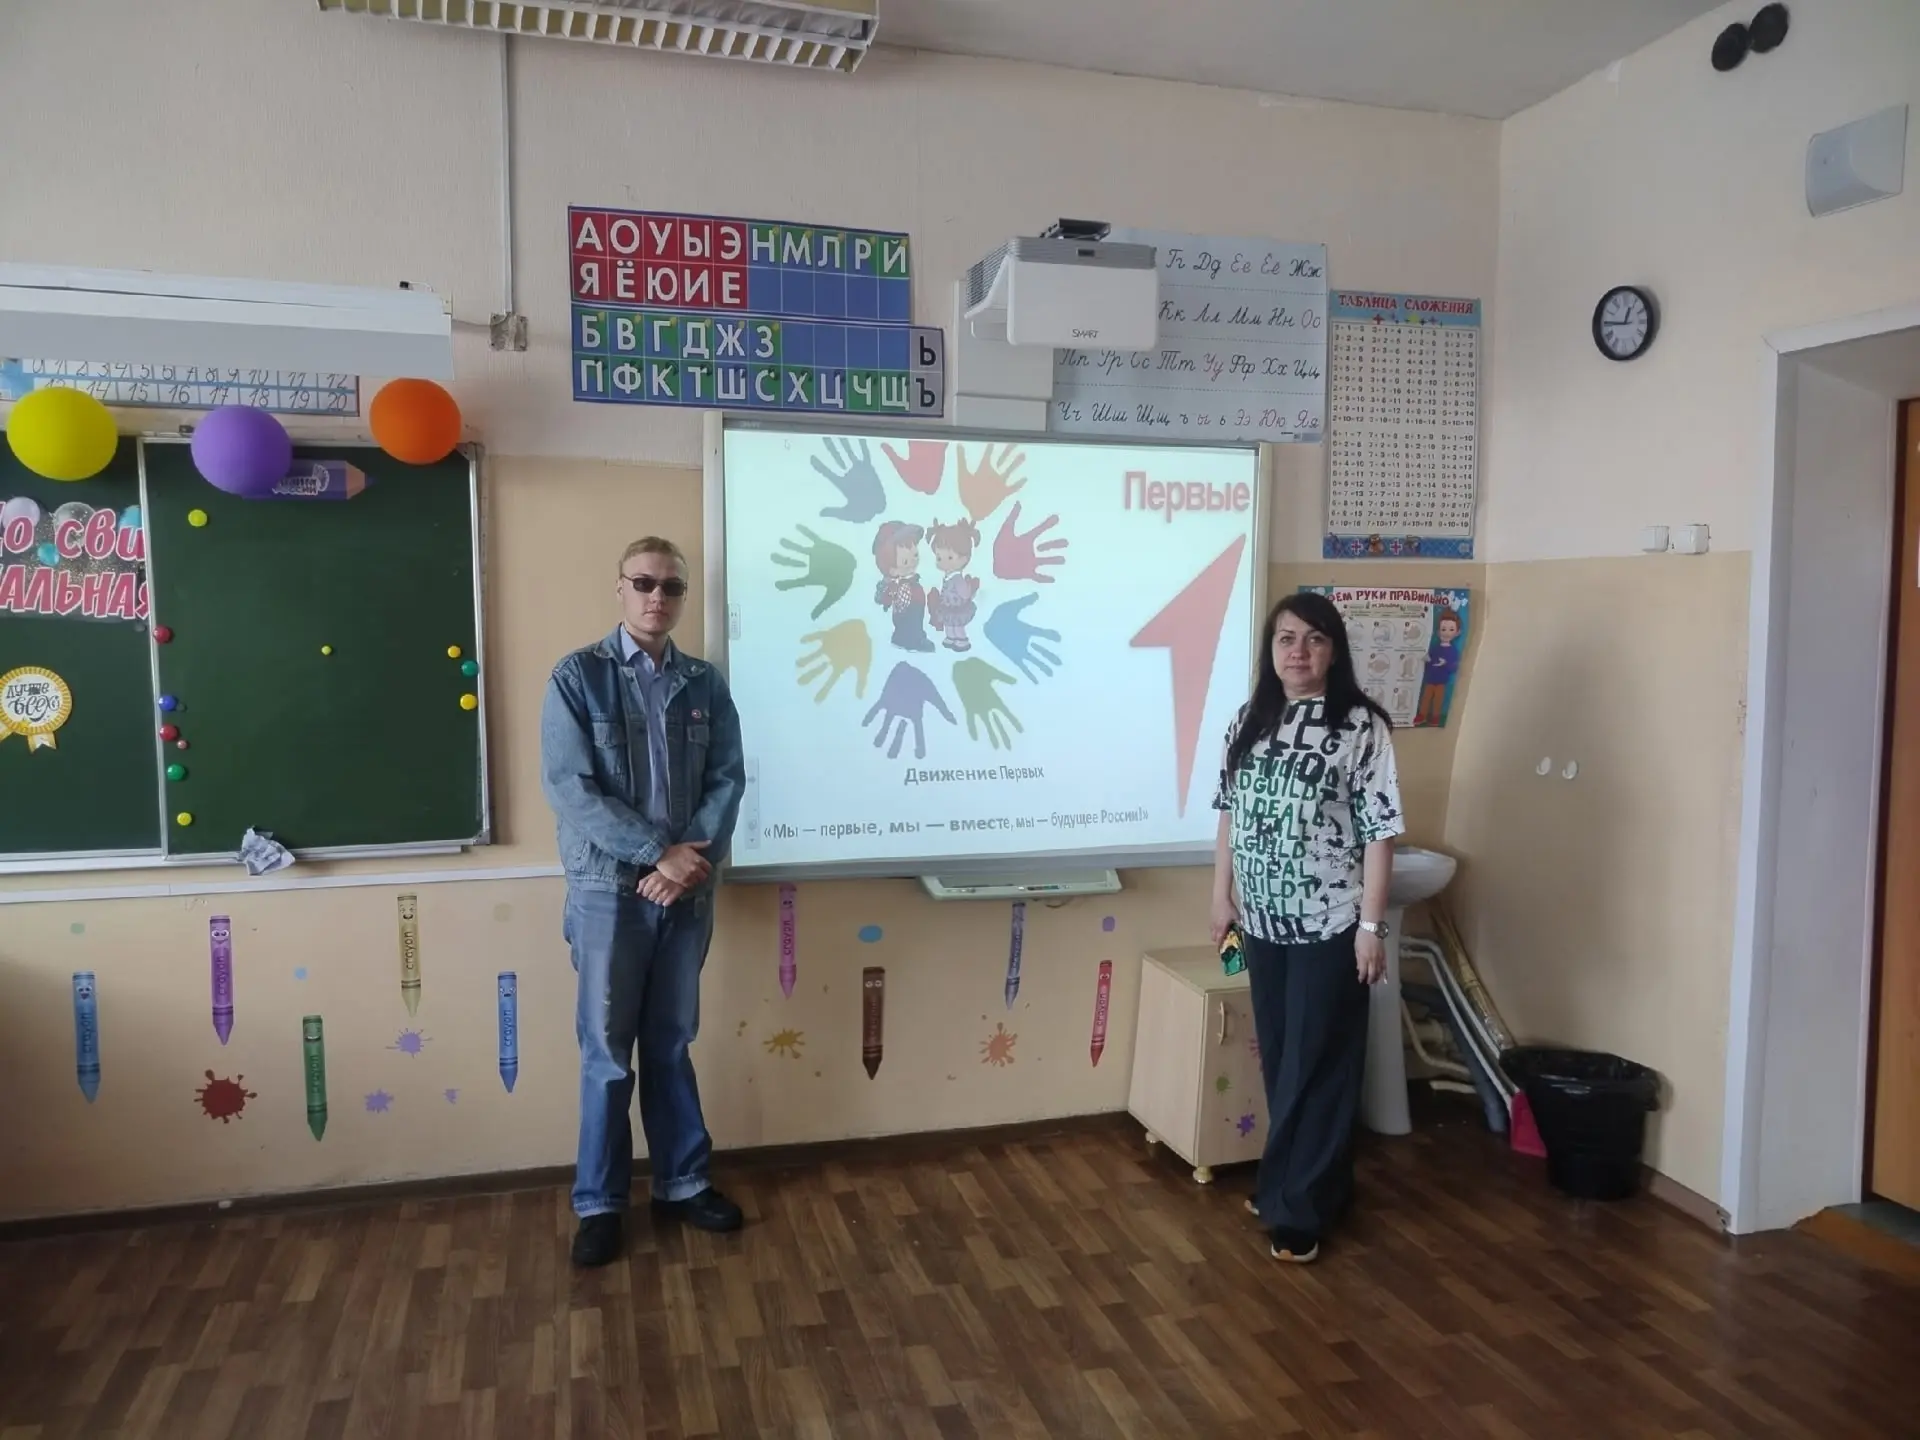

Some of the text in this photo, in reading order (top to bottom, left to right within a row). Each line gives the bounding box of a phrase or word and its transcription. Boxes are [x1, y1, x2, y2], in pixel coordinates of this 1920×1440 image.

[1338, 294, 1474, 315] ТАБЛИЦА СЛОЖЕНИЯ
[1124, 470, 1251, 524] Первые
[0, 502, 146, 561] о сви
[0, 563, 151, 620] АЛЬНАЯ
[1328, 591, 1353, 603] ОЕМ
[1356, 590, 1387, 601] РУКИ
[1389, 590, 1450, 606] ПРАВИЛЬНО
[904, 765, 1045, 786] Движение Первых
[764, 823, 798, 838] «Мы
[820, 821, 883, 839] первые,
[889, 820, 920, 833] мы
[949, 815, 1014, 832] вместе,
[1016, 816, 1035, 828] мы
[1051, 811, 1098, 829] будущее
[403, 931, 418, 970] crayon
[782, 919, 794, 955] crayon
[80, 1012, 96, 1054] crayon
[502, 1009, 516, 1048] crayon
